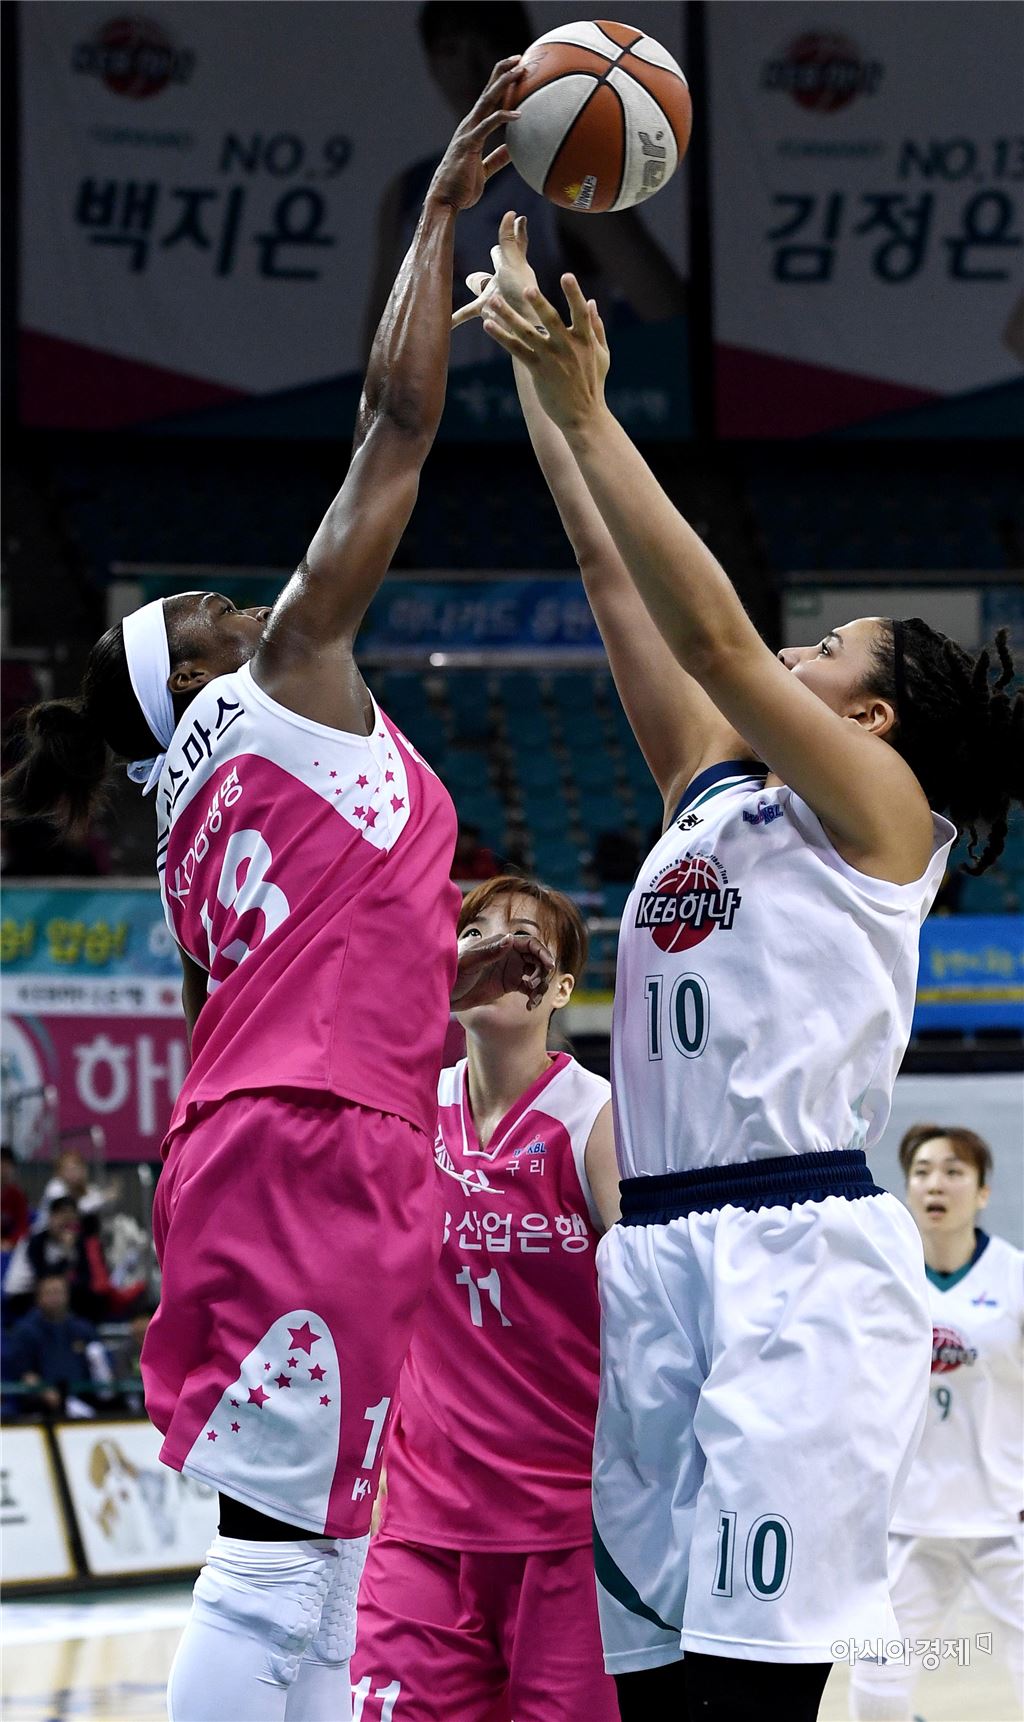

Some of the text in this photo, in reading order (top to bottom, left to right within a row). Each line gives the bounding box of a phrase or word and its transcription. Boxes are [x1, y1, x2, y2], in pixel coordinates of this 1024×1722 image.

[220, 133, 354, 178] NO.9
[74, 176, 335, 281] 백지은
[767, 187, 1024, 284] 김정은
[635, 887, 741, 930] KEB하나
[644, 971, 711, 1061] 10
[456, 1265, 512, 1327] 11
[936, 1387, 951, 1421] 9
[711, 1509, 794, 1602] 10
